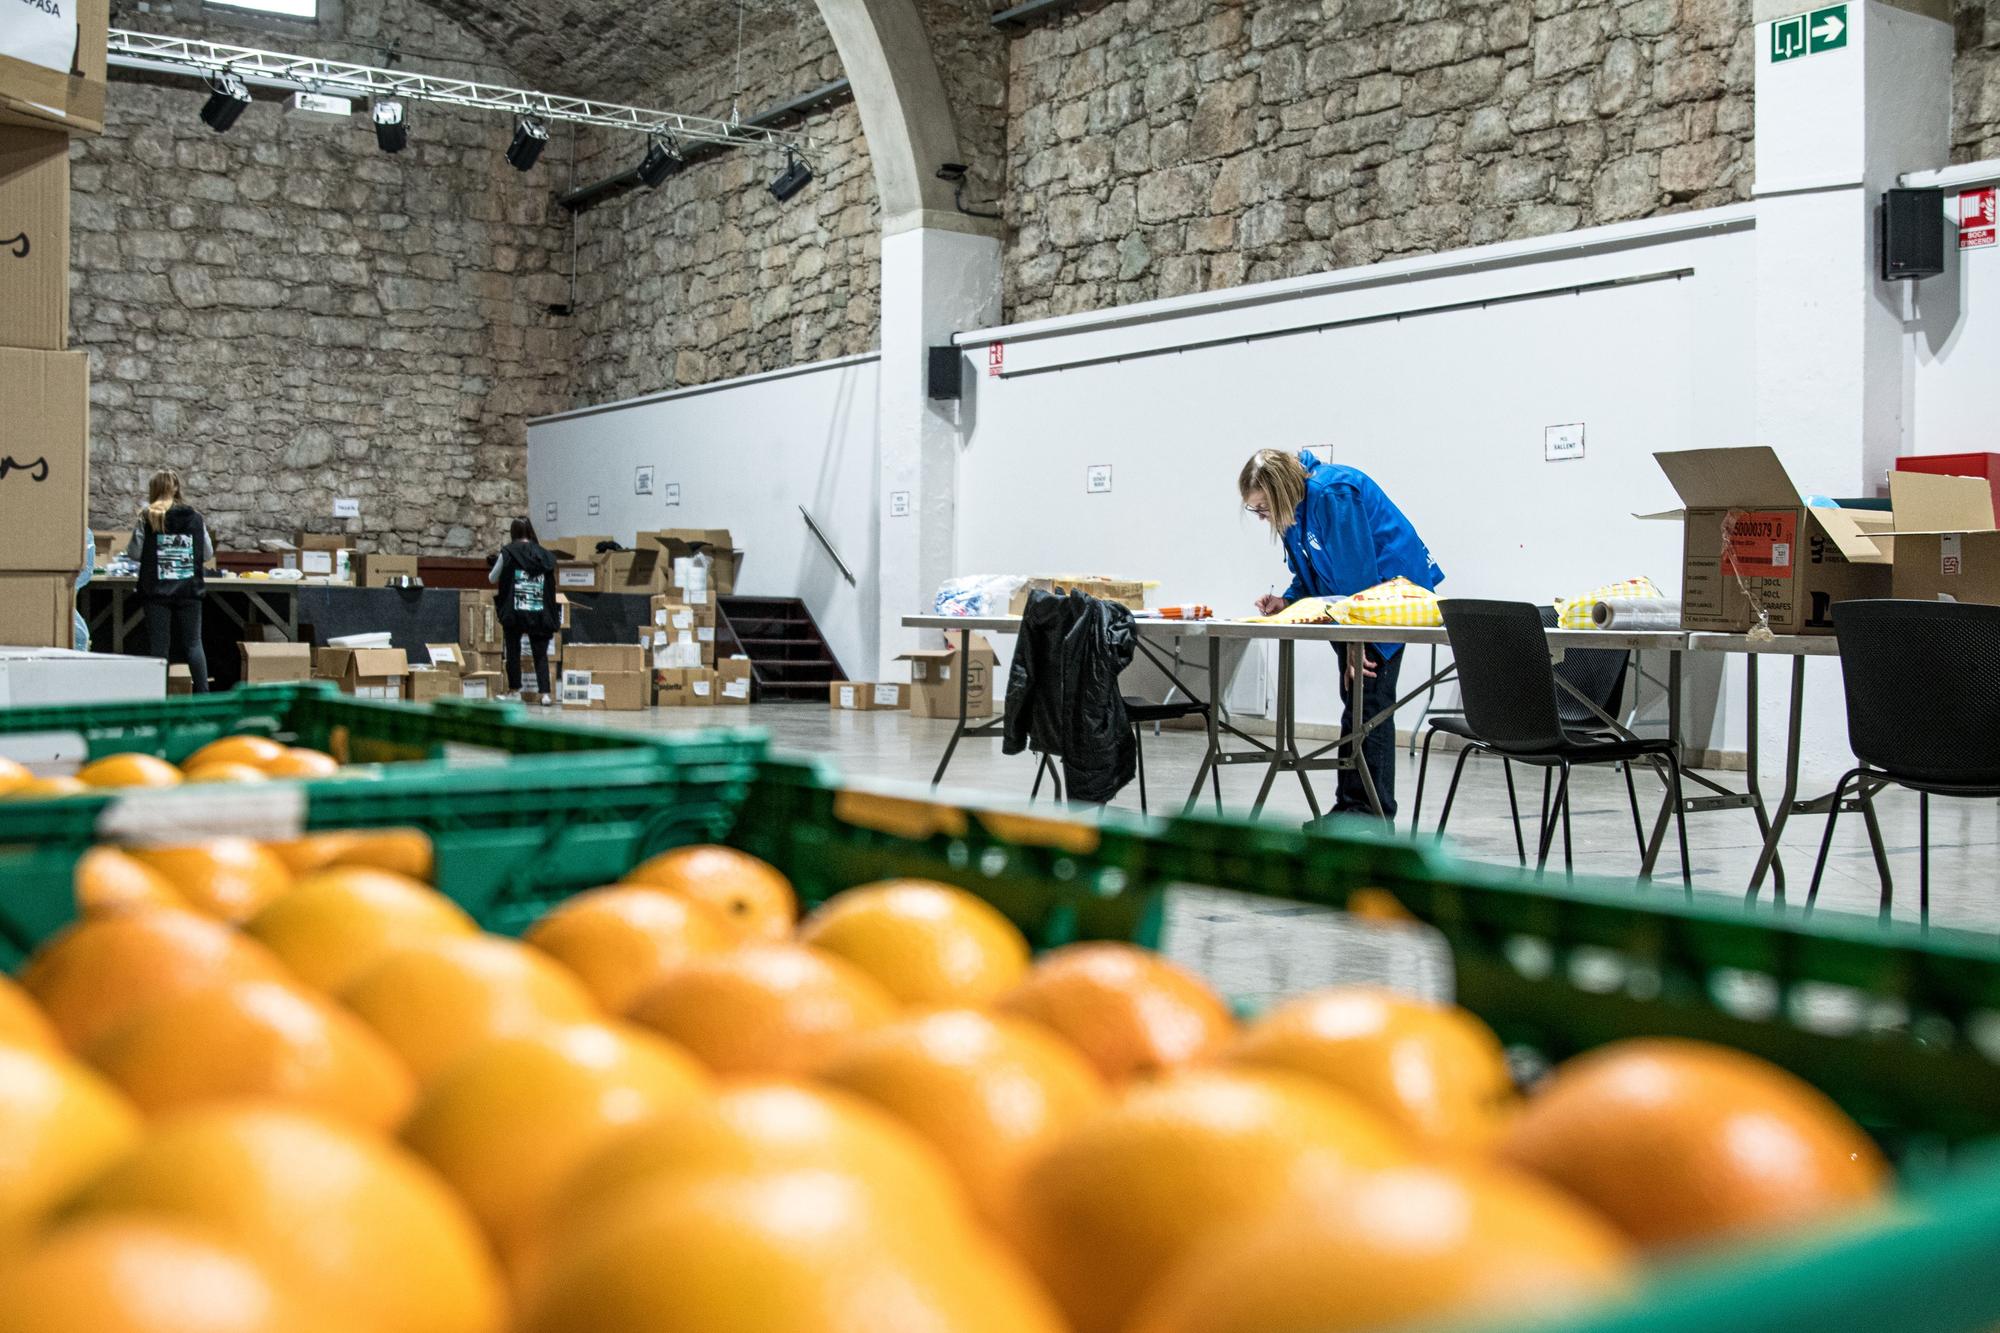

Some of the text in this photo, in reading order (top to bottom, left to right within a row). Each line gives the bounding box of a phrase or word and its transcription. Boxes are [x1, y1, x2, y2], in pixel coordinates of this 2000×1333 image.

[1967, 230, 1987, 239] BOCA
[1763, 578, 1772, 586] 30
[1763, 590, 1772, 598] 40
[1763, 602, 1792, 610] CARAFES
